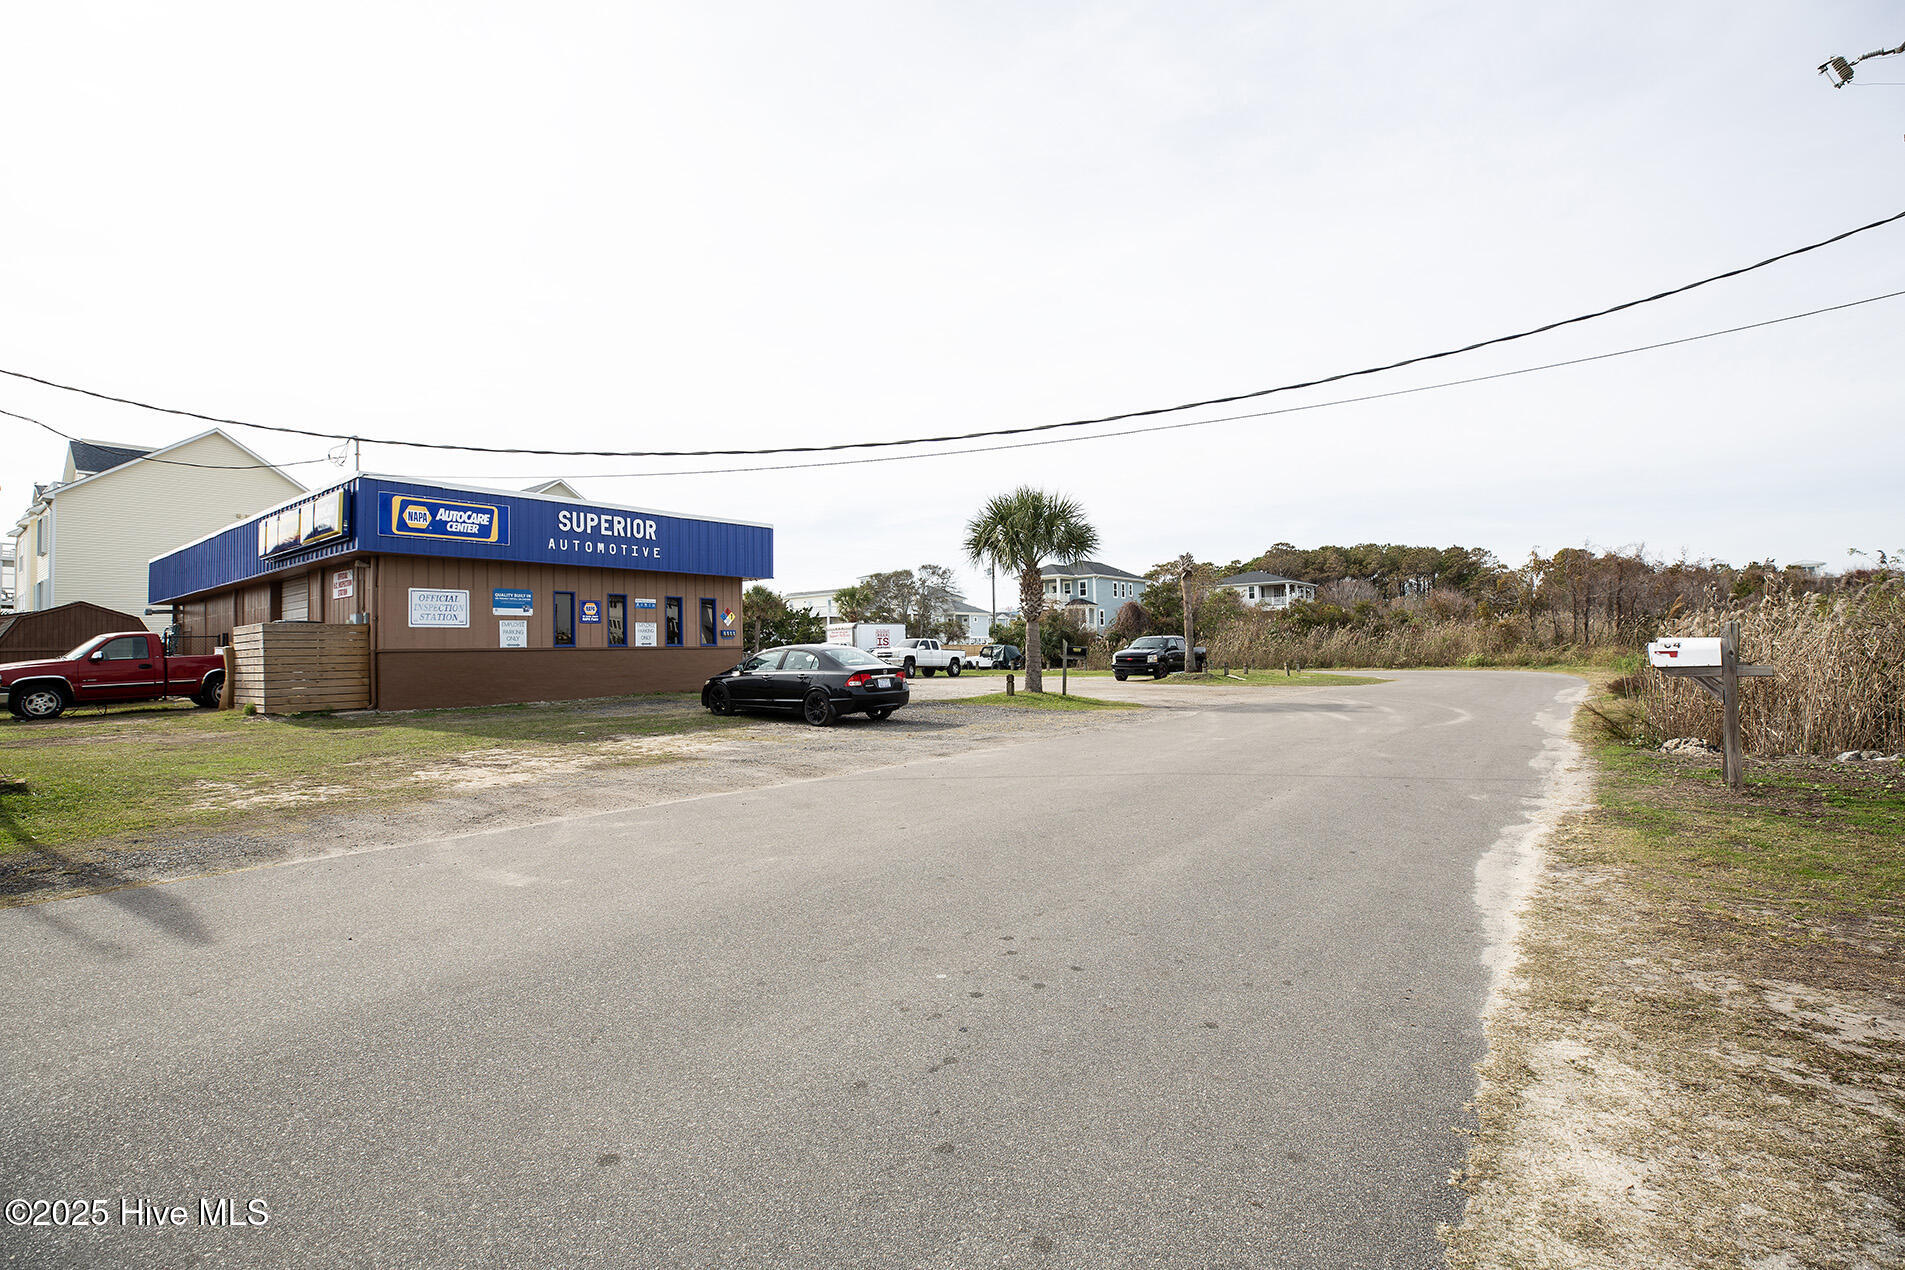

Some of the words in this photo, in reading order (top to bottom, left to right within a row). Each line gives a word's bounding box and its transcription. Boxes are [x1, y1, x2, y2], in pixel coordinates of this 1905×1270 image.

[407, 510, 428, 524] NAPA
[446, 522, 479, 534] CENTER
[558, 510, 657, 540] SUPERIOR
[548, 538, 661, 558] AUTOMOTIVE
[418, 593, 459, 602] OFFICIAL
[414, 603, 465, 612] INSPECTION
[419, 612, 458, 621] STATION
[877, 637, 890, 646] IS
